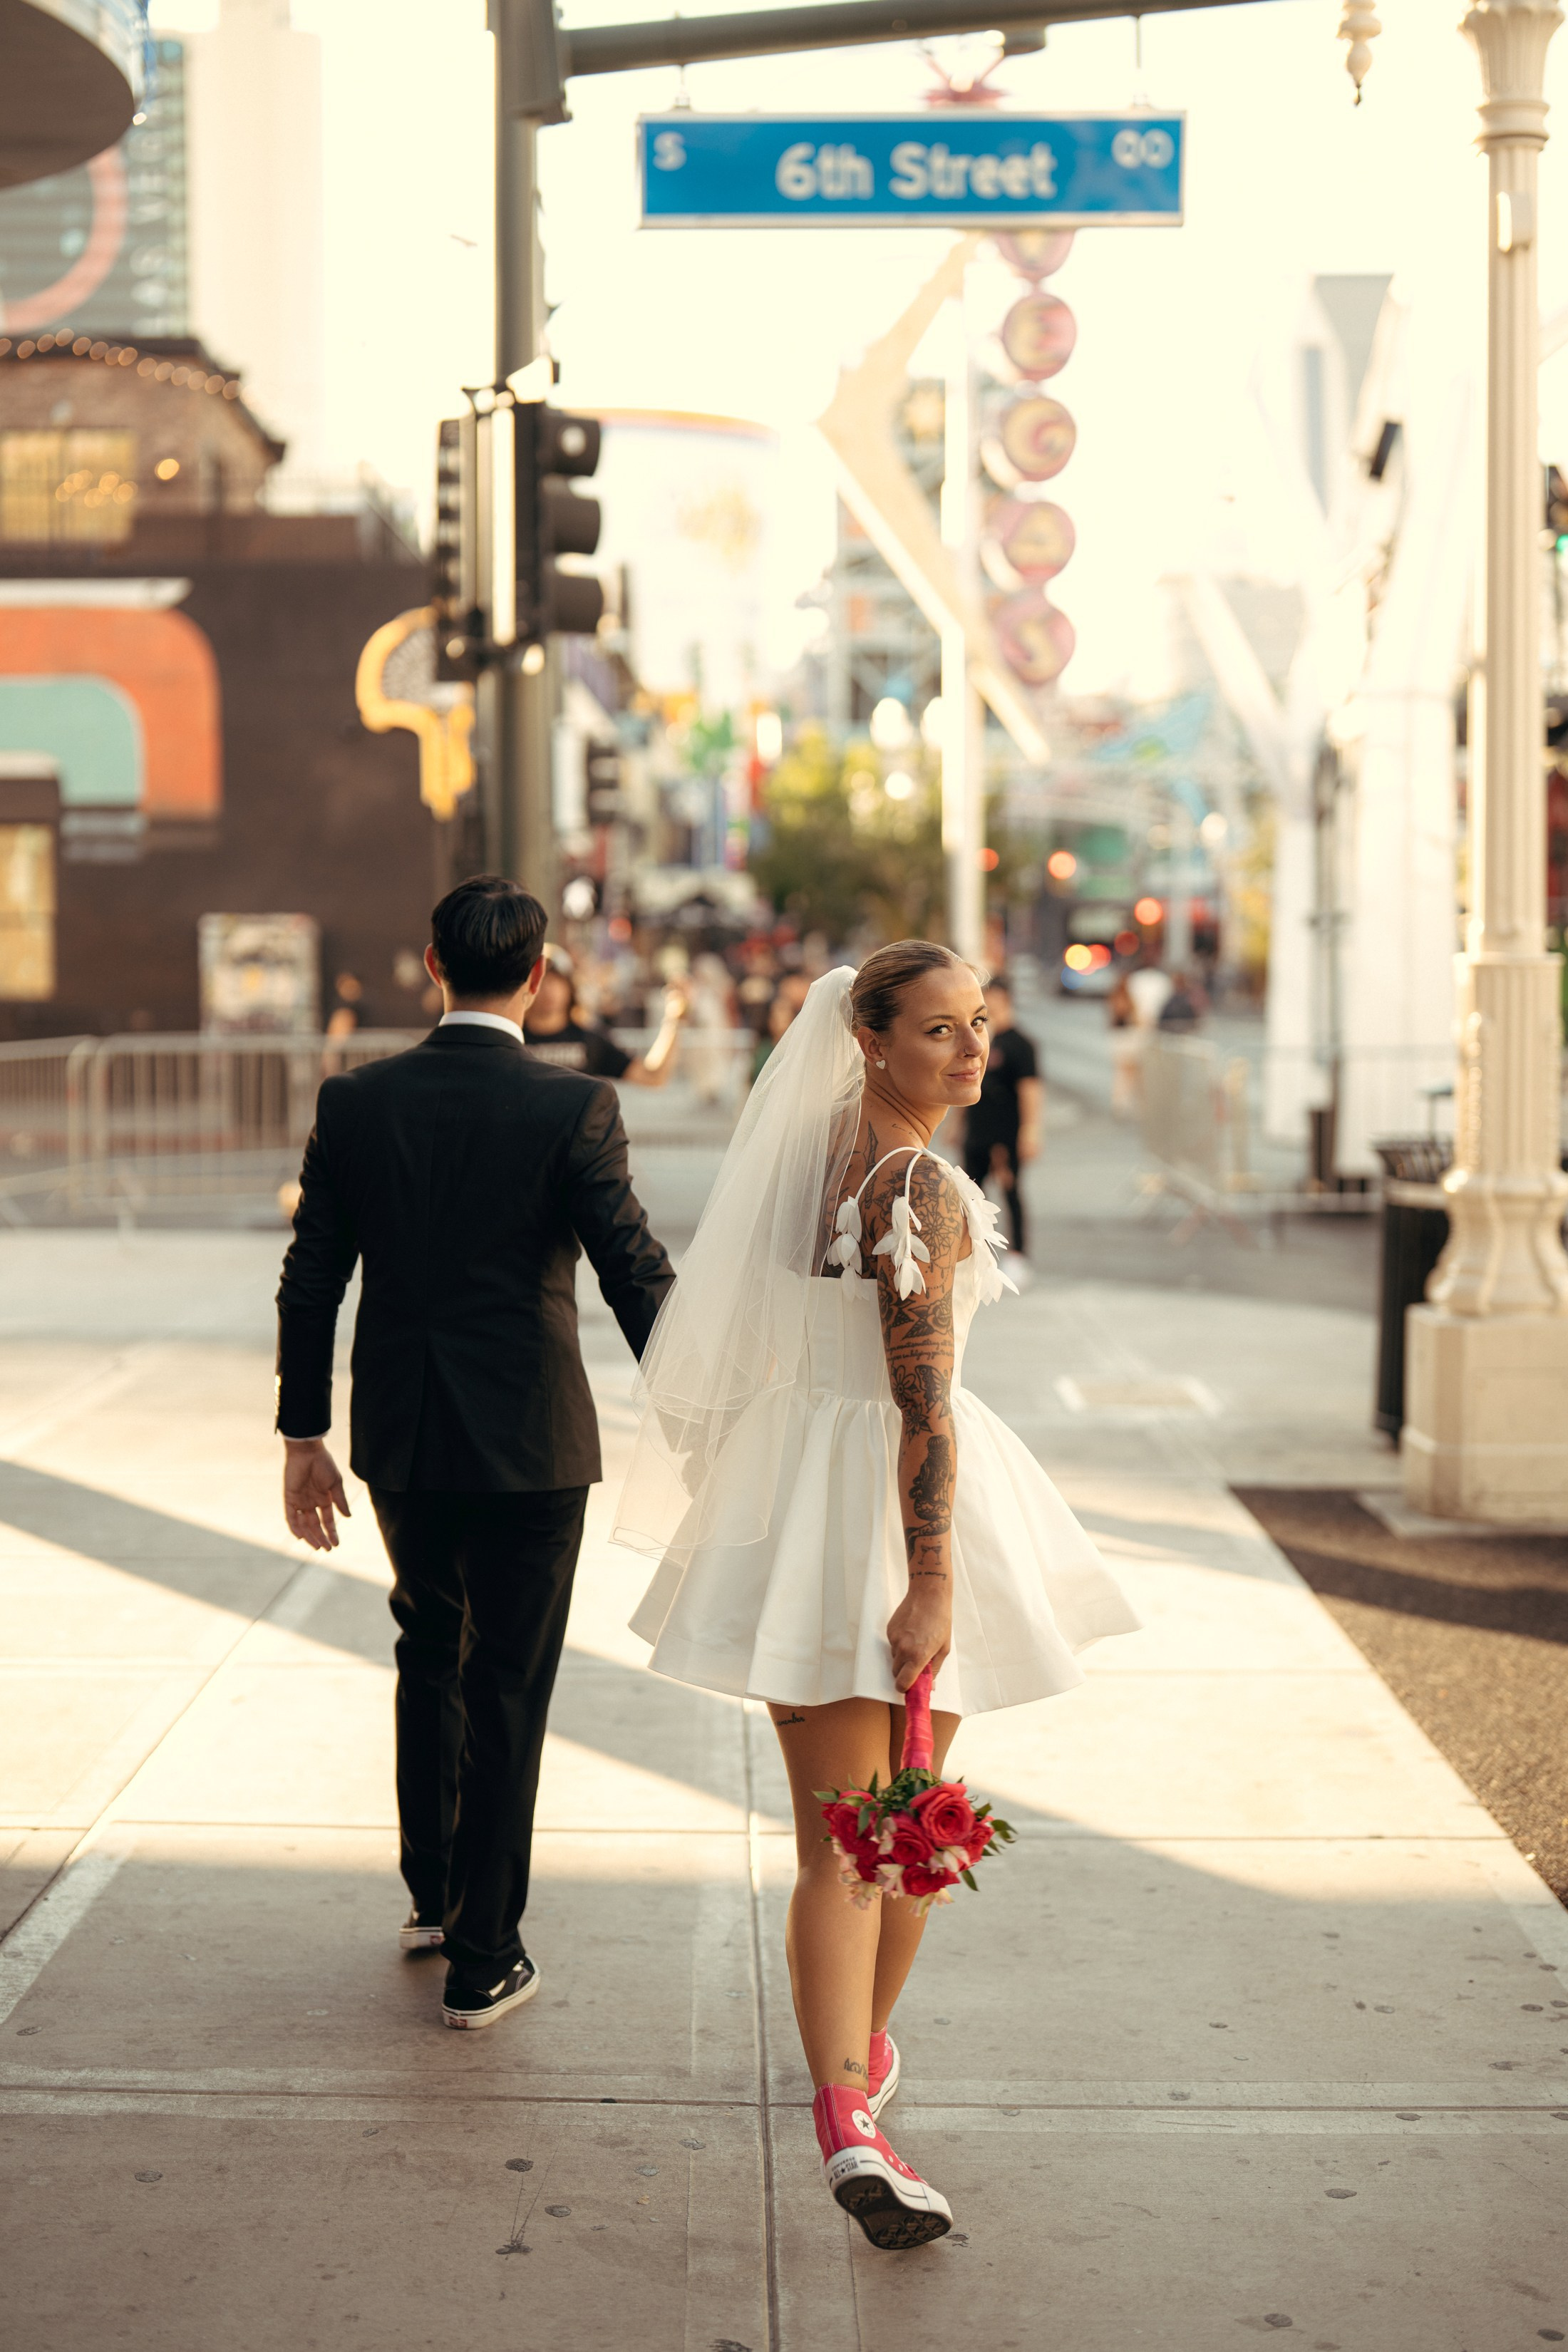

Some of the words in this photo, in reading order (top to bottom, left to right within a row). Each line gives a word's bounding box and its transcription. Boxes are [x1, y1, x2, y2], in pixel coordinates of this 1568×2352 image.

[654, 131, 686, 171] S
[775, 142, 875, 200] 6th
[889, 141, 1058, 200] Street
[845, 2160, 859, 2172] STAR
